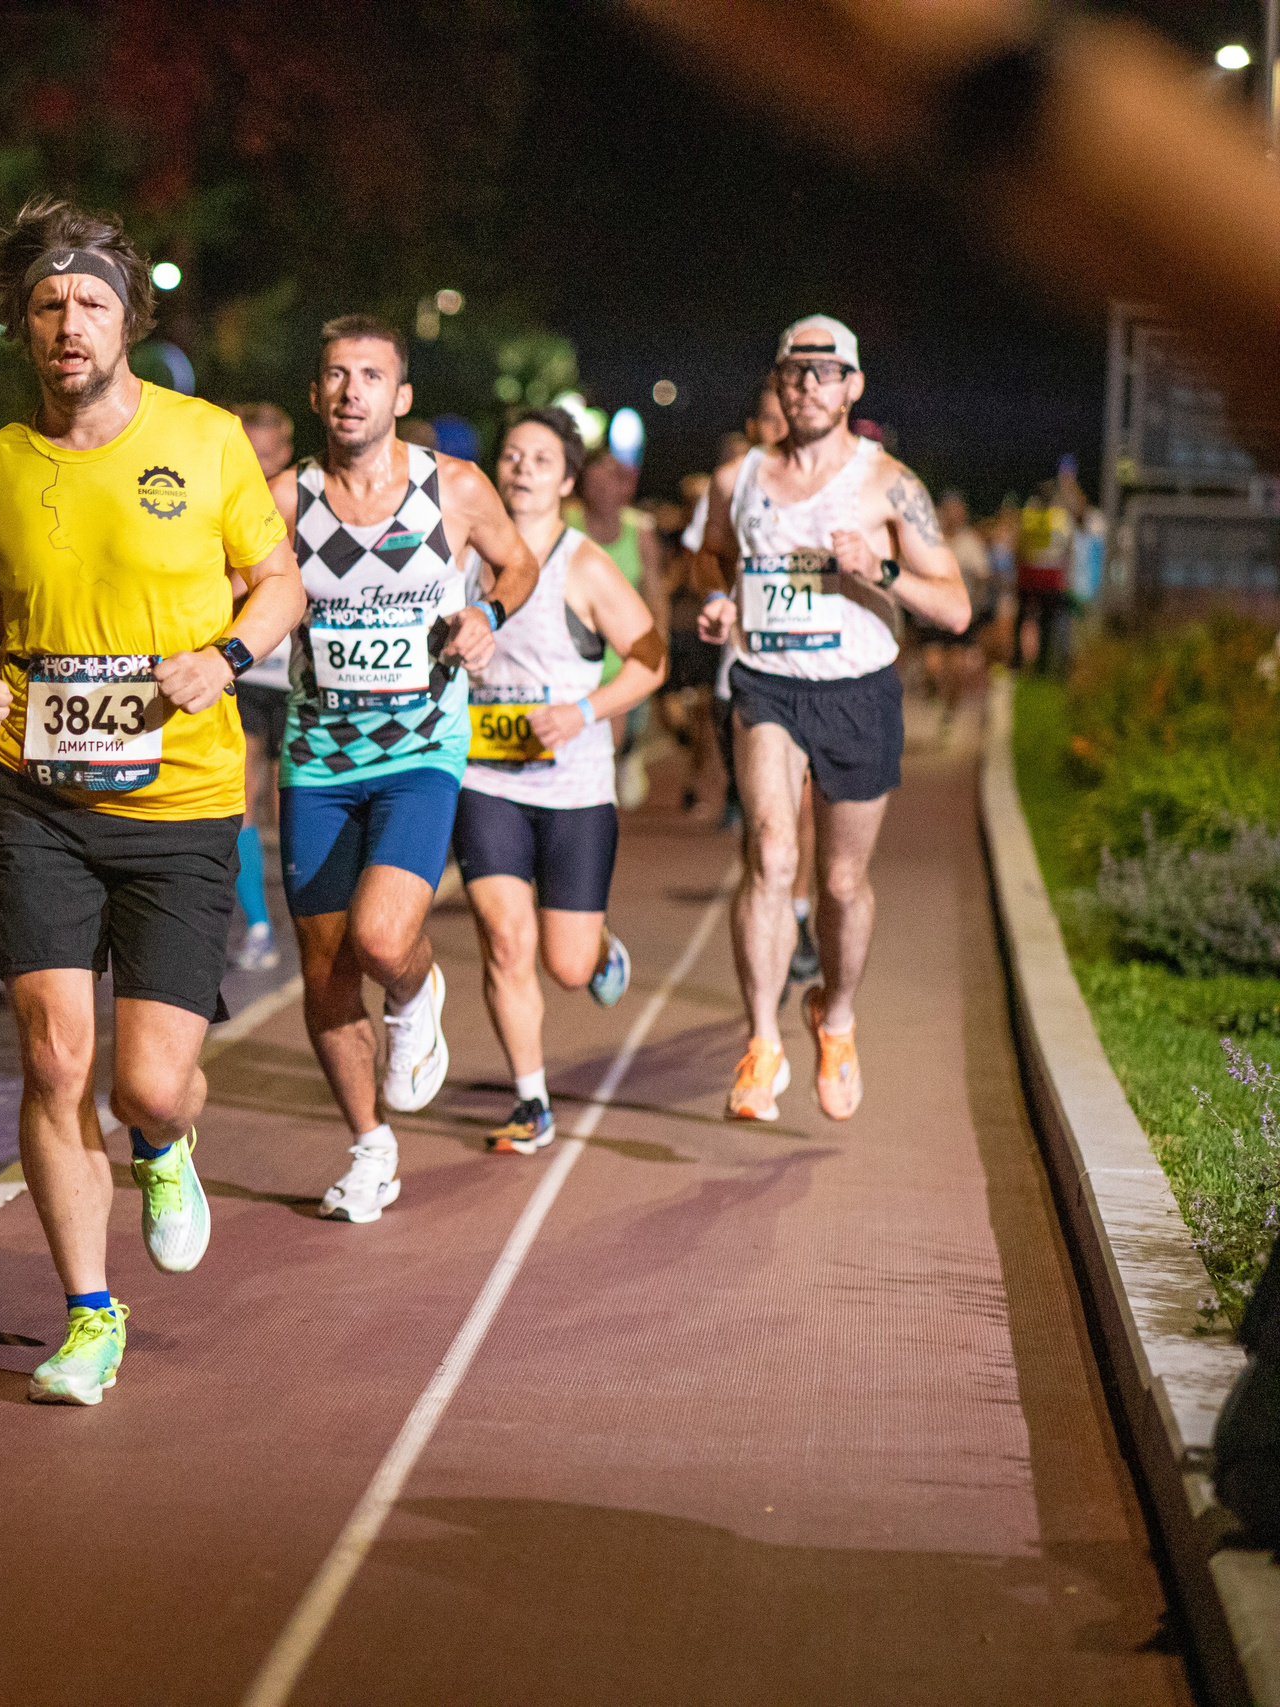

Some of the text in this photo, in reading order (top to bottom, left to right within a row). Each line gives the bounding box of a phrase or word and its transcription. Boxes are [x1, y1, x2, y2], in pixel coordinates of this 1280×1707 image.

[137, 488, 187, 498] ENGIRUNNERS
[361, 579, 446, 610] Family
[763, 585, 812, 611] 791
[327, 639, 413, 670] 8422
[337, 674, 403, 683] АЛЕКСАНДР
[43, 695, 145, 735] 3843
[57, 739, 124, 753] ДМИТРИЙ
